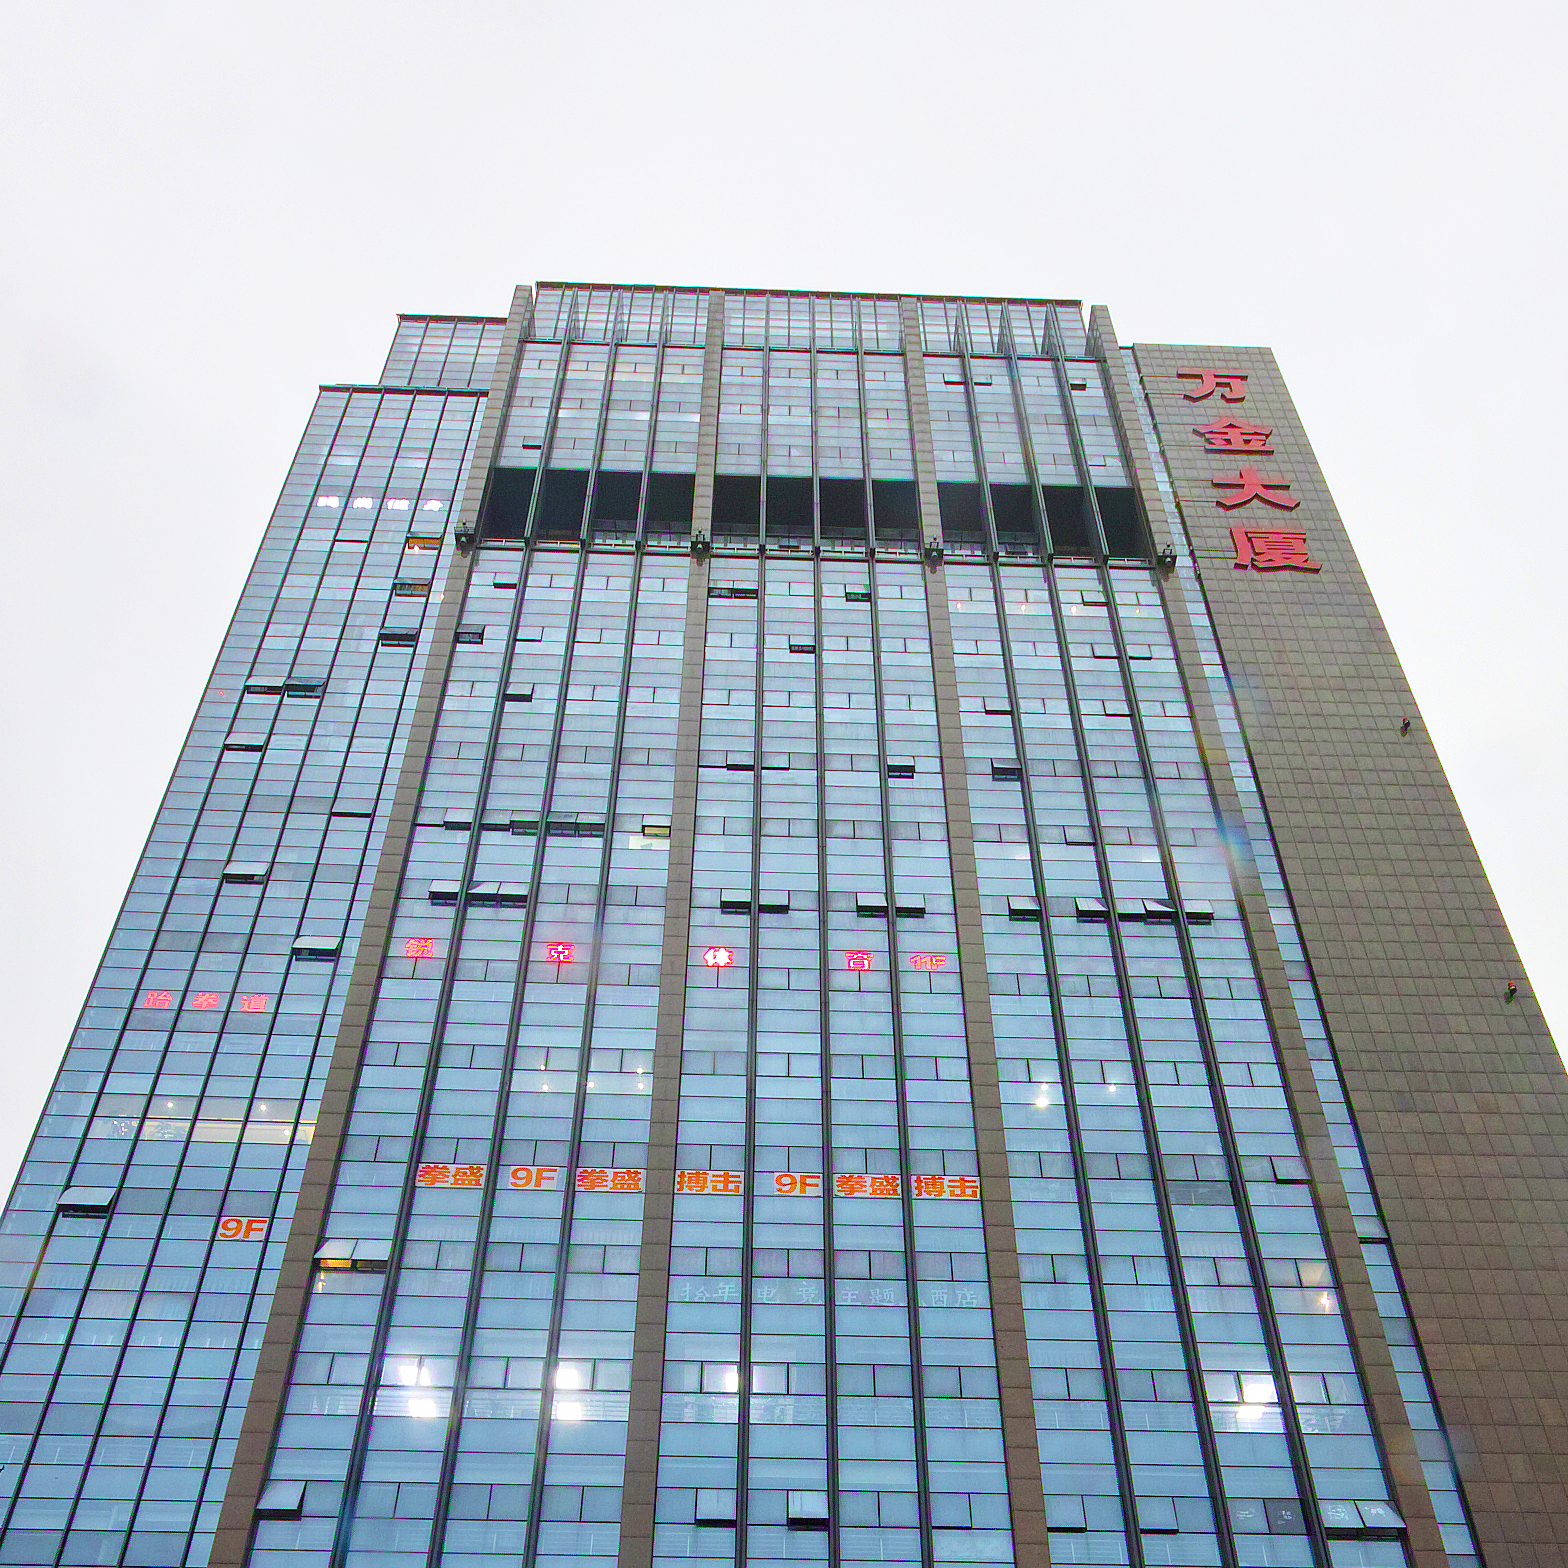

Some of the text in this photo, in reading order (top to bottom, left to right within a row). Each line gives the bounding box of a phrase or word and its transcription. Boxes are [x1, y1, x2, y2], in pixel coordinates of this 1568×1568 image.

[1177, 367, 1323, 575] 万金大厦
[142, 991, 269, 1012] 跆拳道
[417, 1164, 979, 1199] 拳盛 9F 拳盛 搏击 9F 拳盛 搏击
[219, 1218, 268, 1239] 9F
